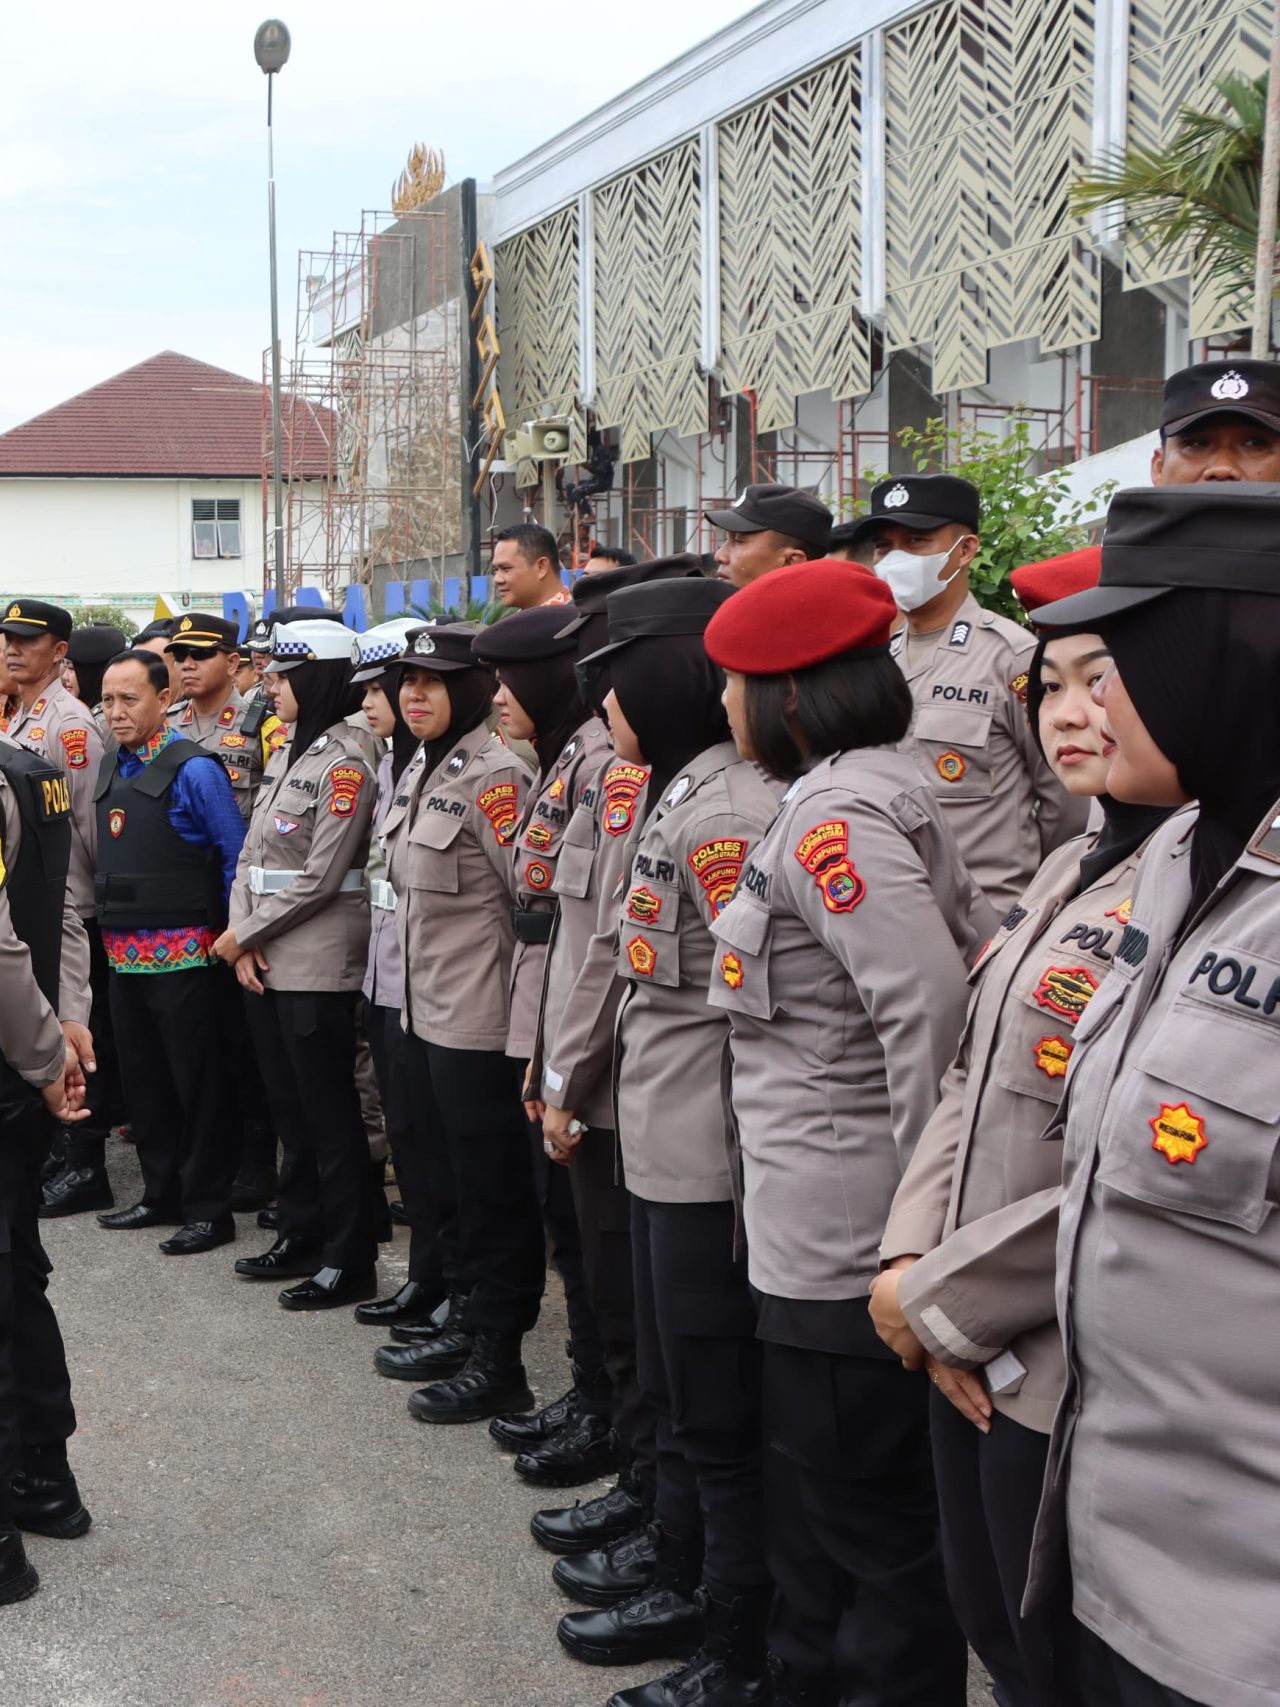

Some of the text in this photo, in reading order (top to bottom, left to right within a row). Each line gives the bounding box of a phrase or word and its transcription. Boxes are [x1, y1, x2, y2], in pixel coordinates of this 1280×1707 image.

[932, 685, 989, 704] POLRI
[480, 786, 514, 805] POLRES
[427, 797, 467, 817] POLRI
[693, 842, 741, 865] POLRES
[809, 844, 843, 868] LAMPUNG
[634, 854, 675, 882] POLRI
[704, 868, 736, 883] LAMPUNG
[1159, 1122, 1196, 1142] RESKRIM
